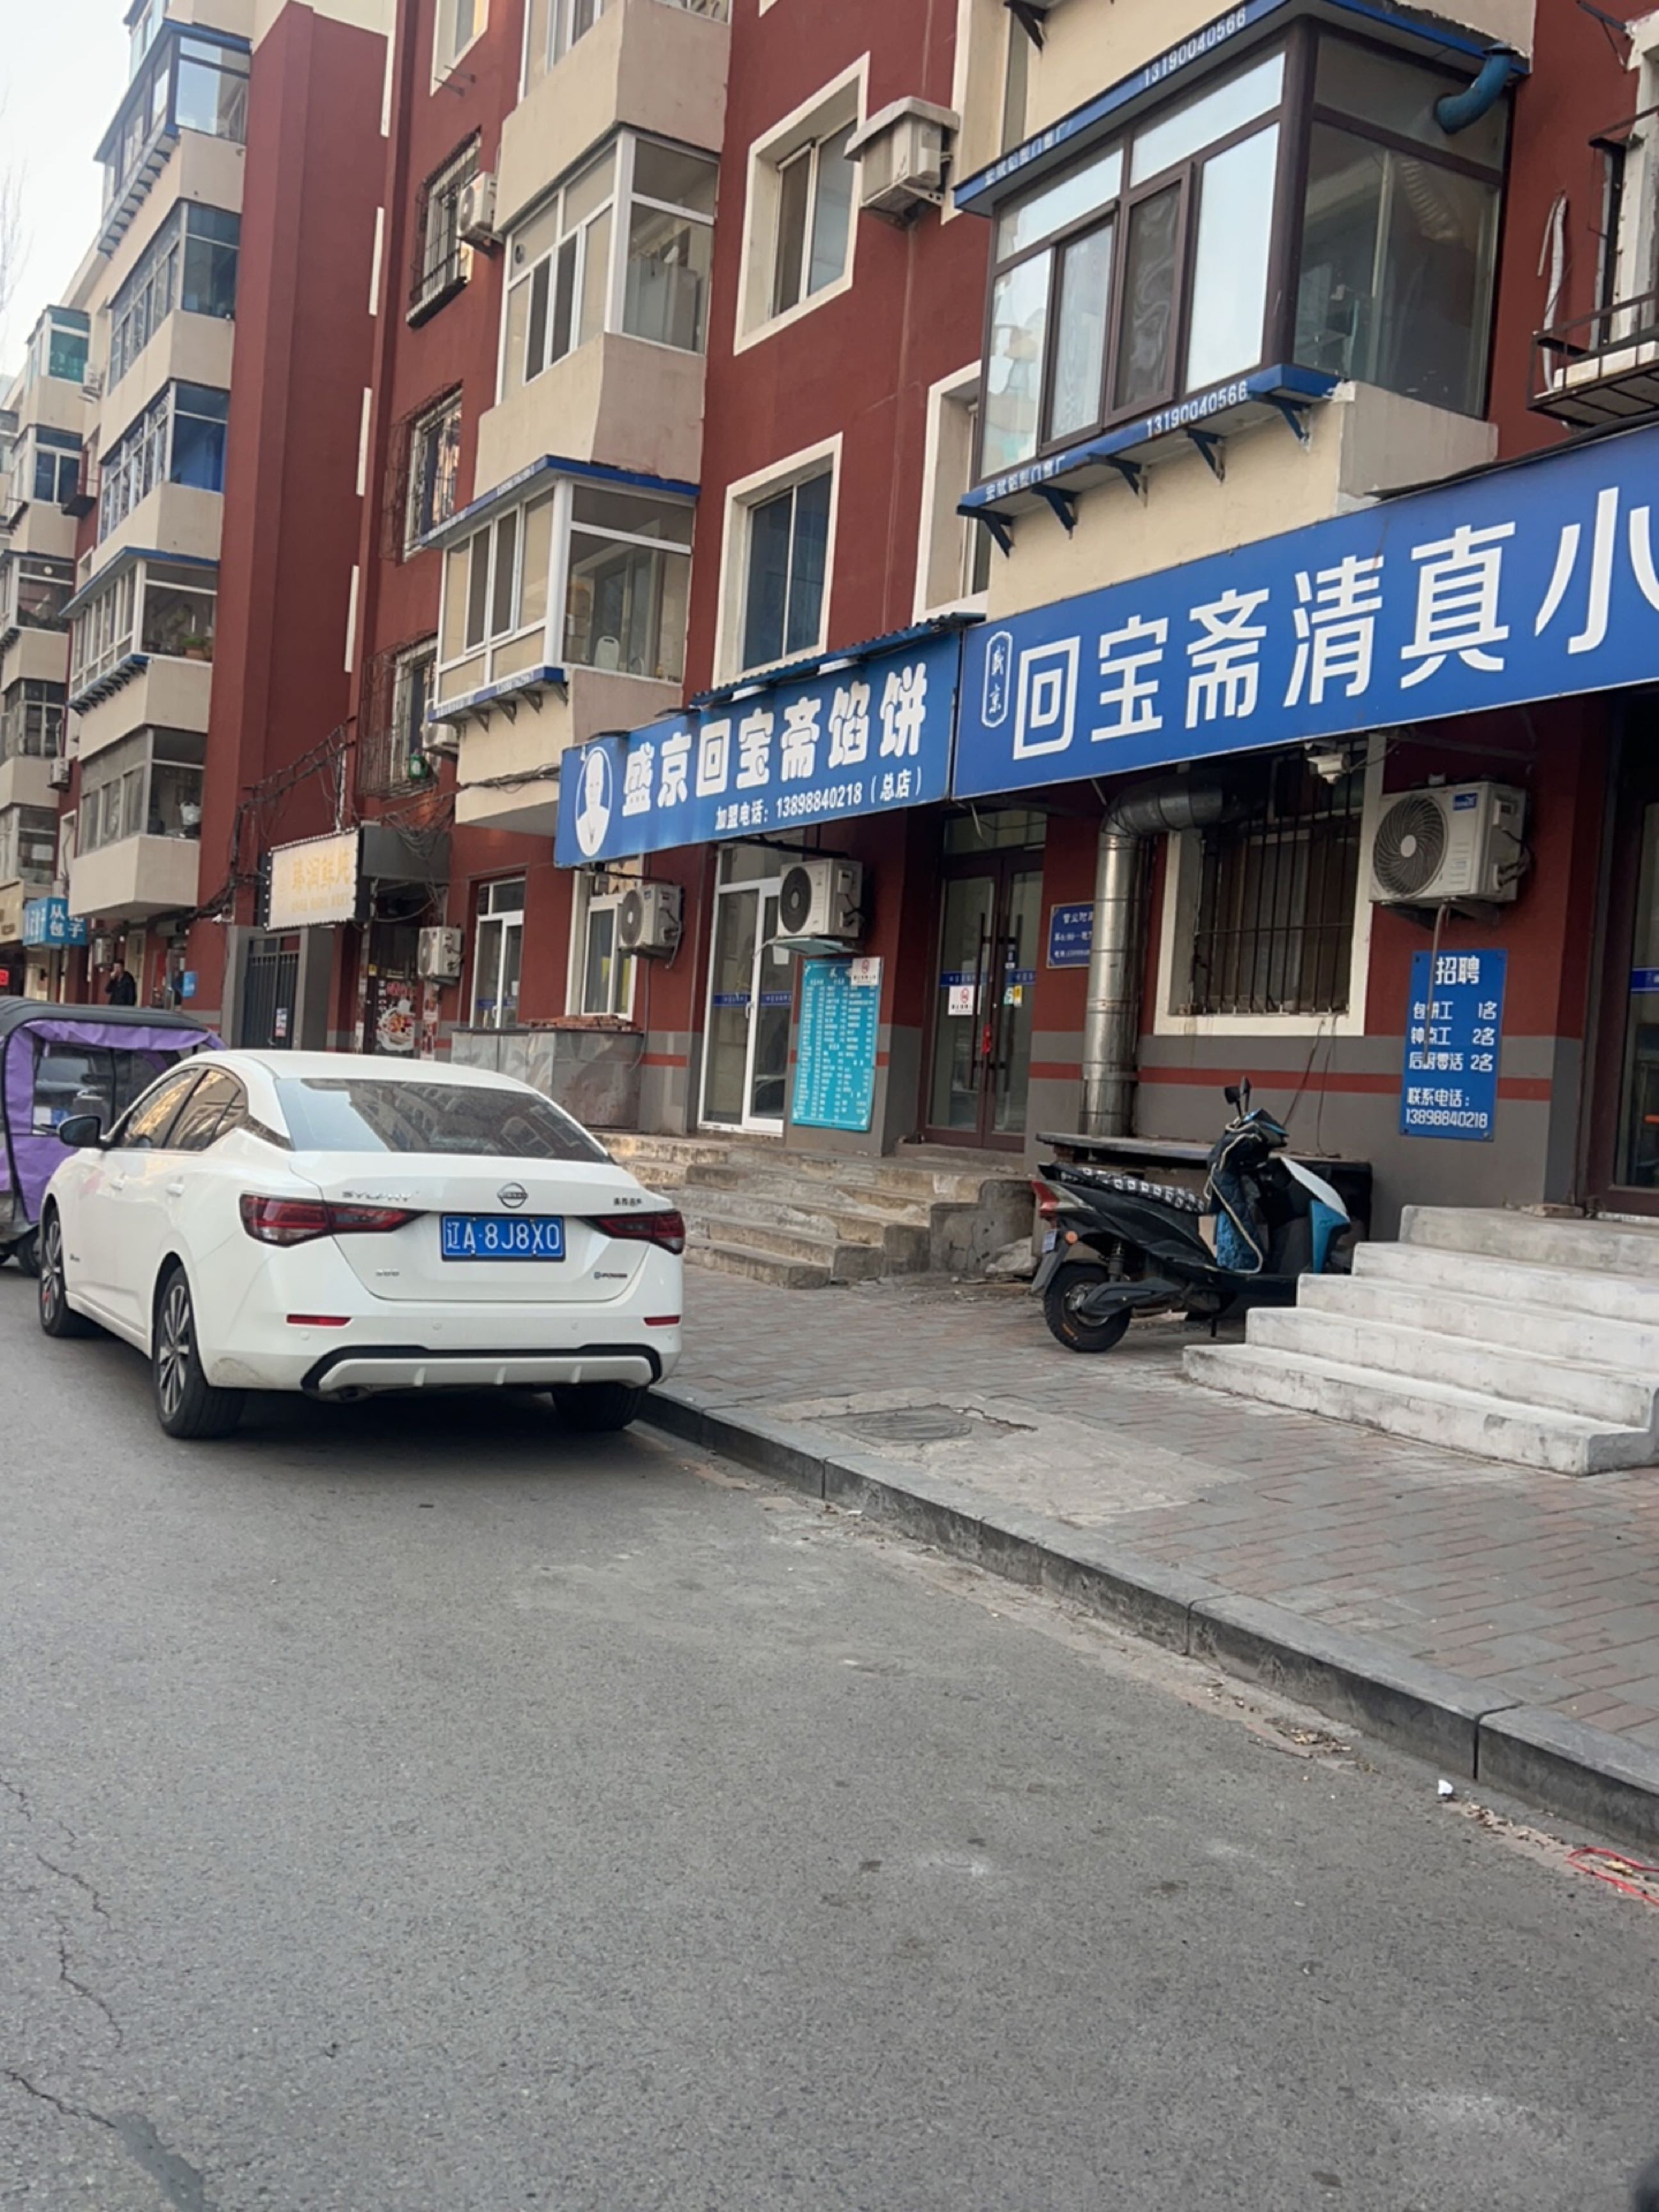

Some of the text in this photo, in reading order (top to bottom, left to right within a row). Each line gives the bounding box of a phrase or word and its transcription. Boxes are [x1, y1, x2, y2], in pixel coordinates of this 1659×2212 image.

[1144, 6, 1246, 87] 13190040566
[1146, 379, 1247, 438] 13190040566
[1013, 487, 1659, 760] 回宝斋清真小
[621, 662, 928, 817] 盛京回宝斋馅饼
[1434, 955, 1480, 985] 招聘
[1472, 1027, 1496, 1046] 2名
[1470, 1054, 1493, 1072] 2名
[1406, 1109, 1488, 1129] 13898840218
